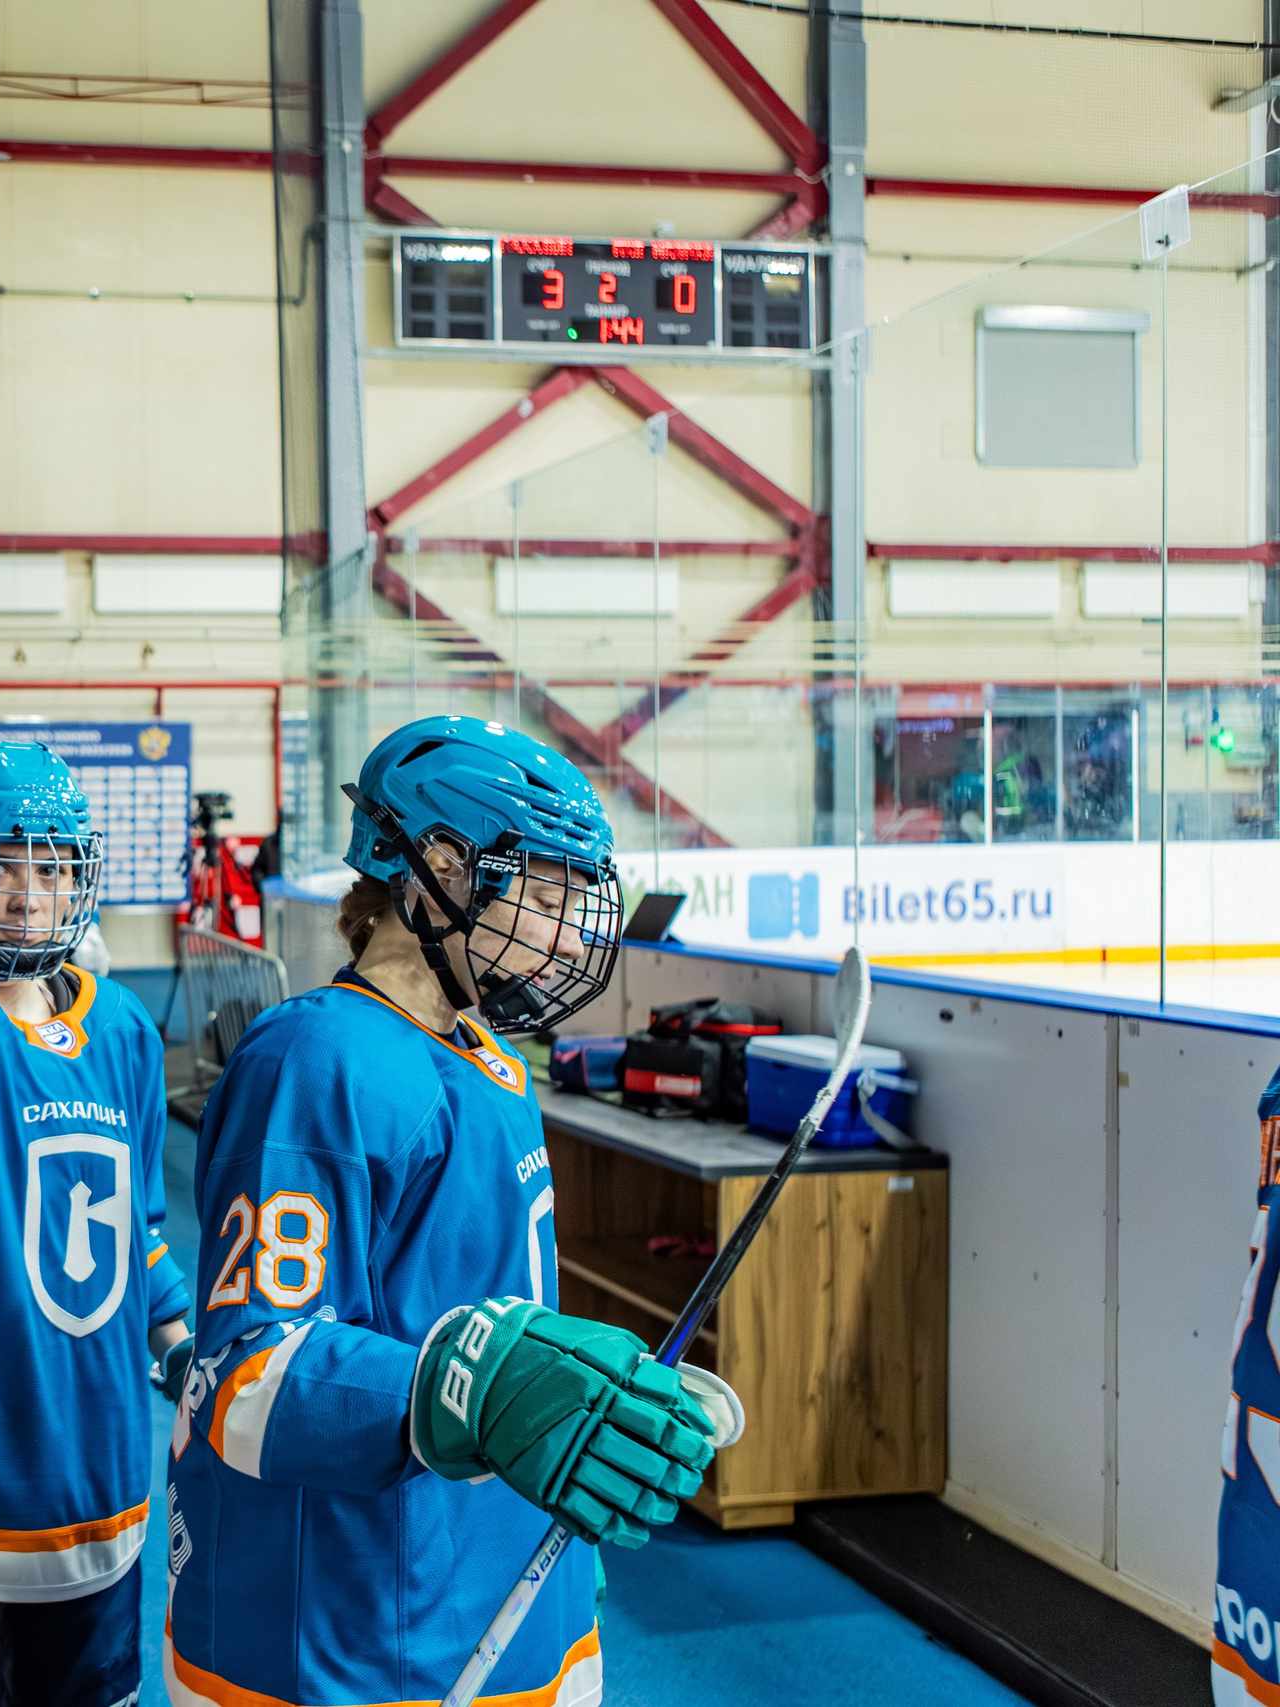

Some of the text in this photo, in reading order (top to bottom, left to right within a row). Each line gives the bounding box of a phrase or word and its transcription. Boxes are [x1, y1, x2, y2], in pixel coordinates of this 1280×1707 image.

[542, 269, 564, 310] 3
[598, 272, 617, 303] 2
[673, 274, 697, 314] 0
[477, 859, 521, 874] CCM
[842, 880, 1053, 925] Bilet65.ru
[23, 1101, 127, 1128] САХАЛИН
[206, 1190, 329, 1312] 28
